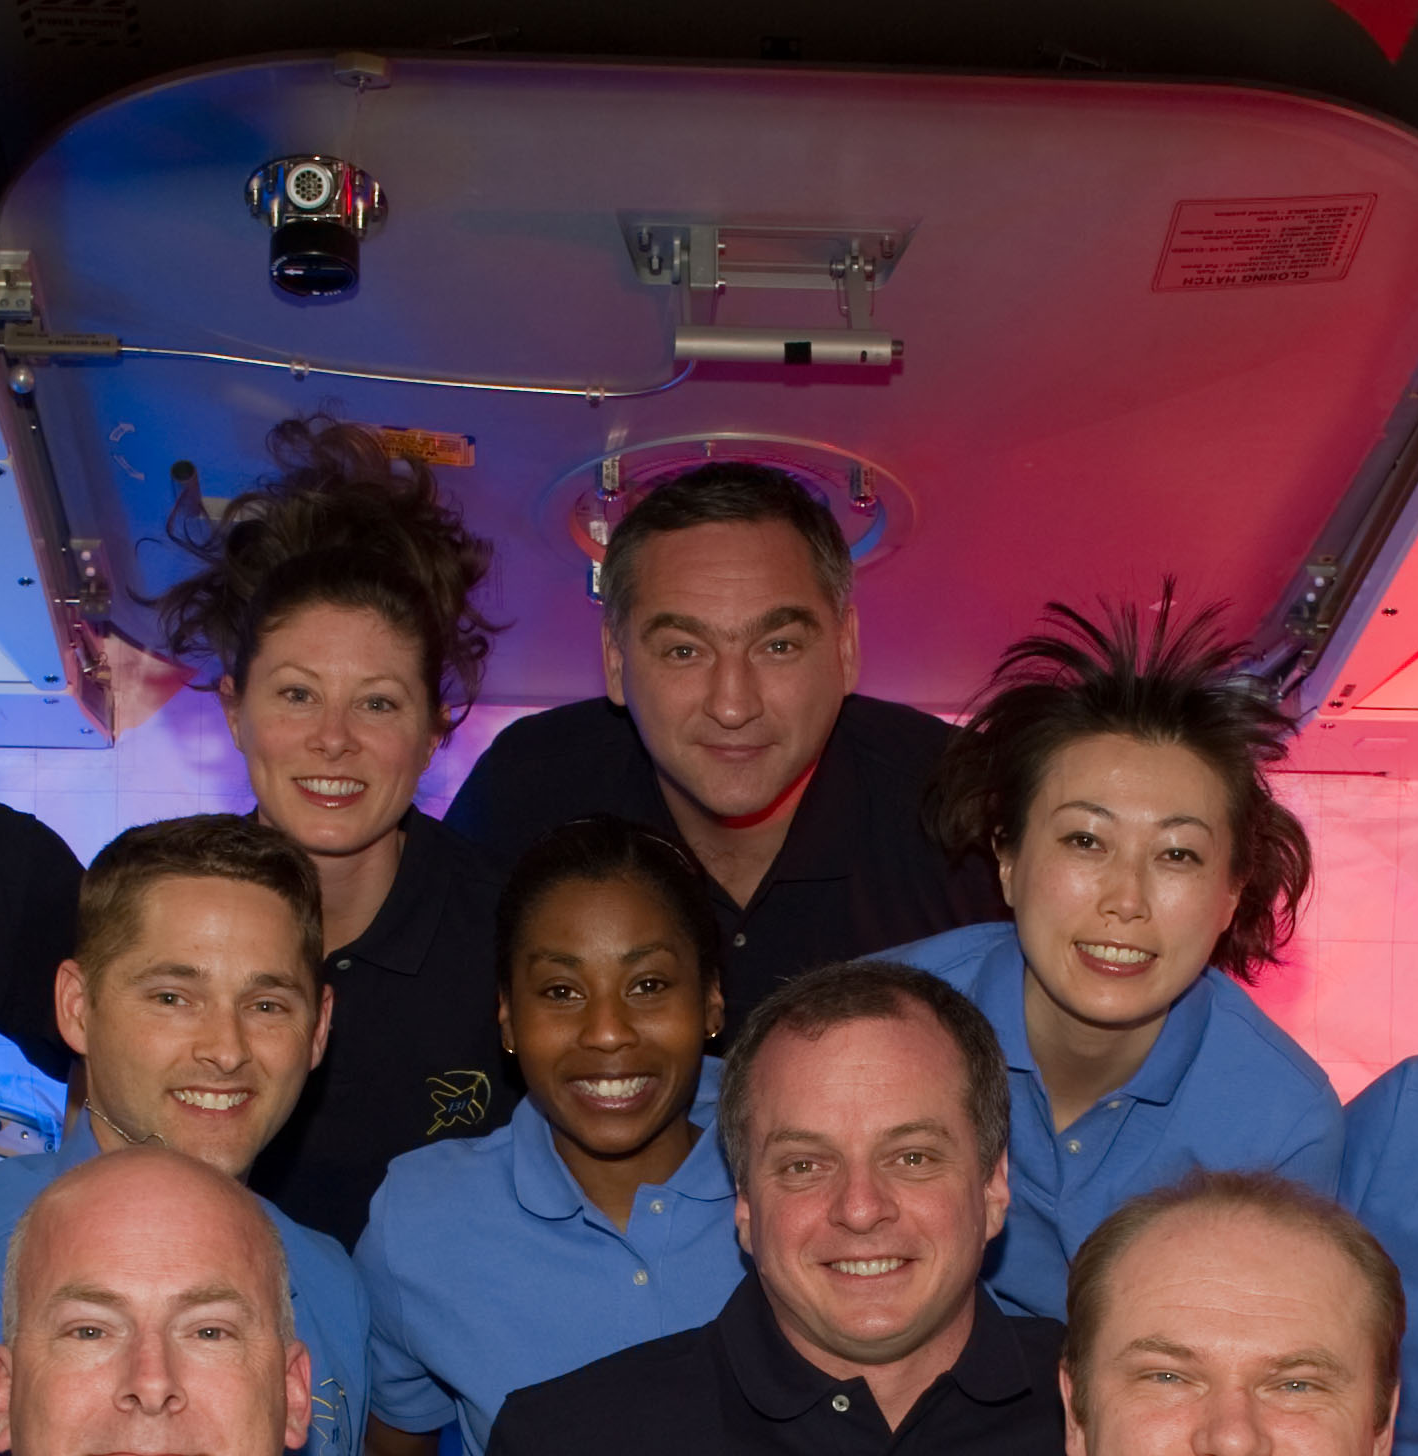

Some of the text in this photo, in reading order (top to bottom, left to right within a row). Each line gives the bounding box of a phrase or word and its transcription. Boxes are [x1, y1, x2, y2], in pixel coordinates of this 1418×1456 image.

[1180, 269, 1311, 287] CLOSING HATCH
[448, 1099, 470, 1113] 131
